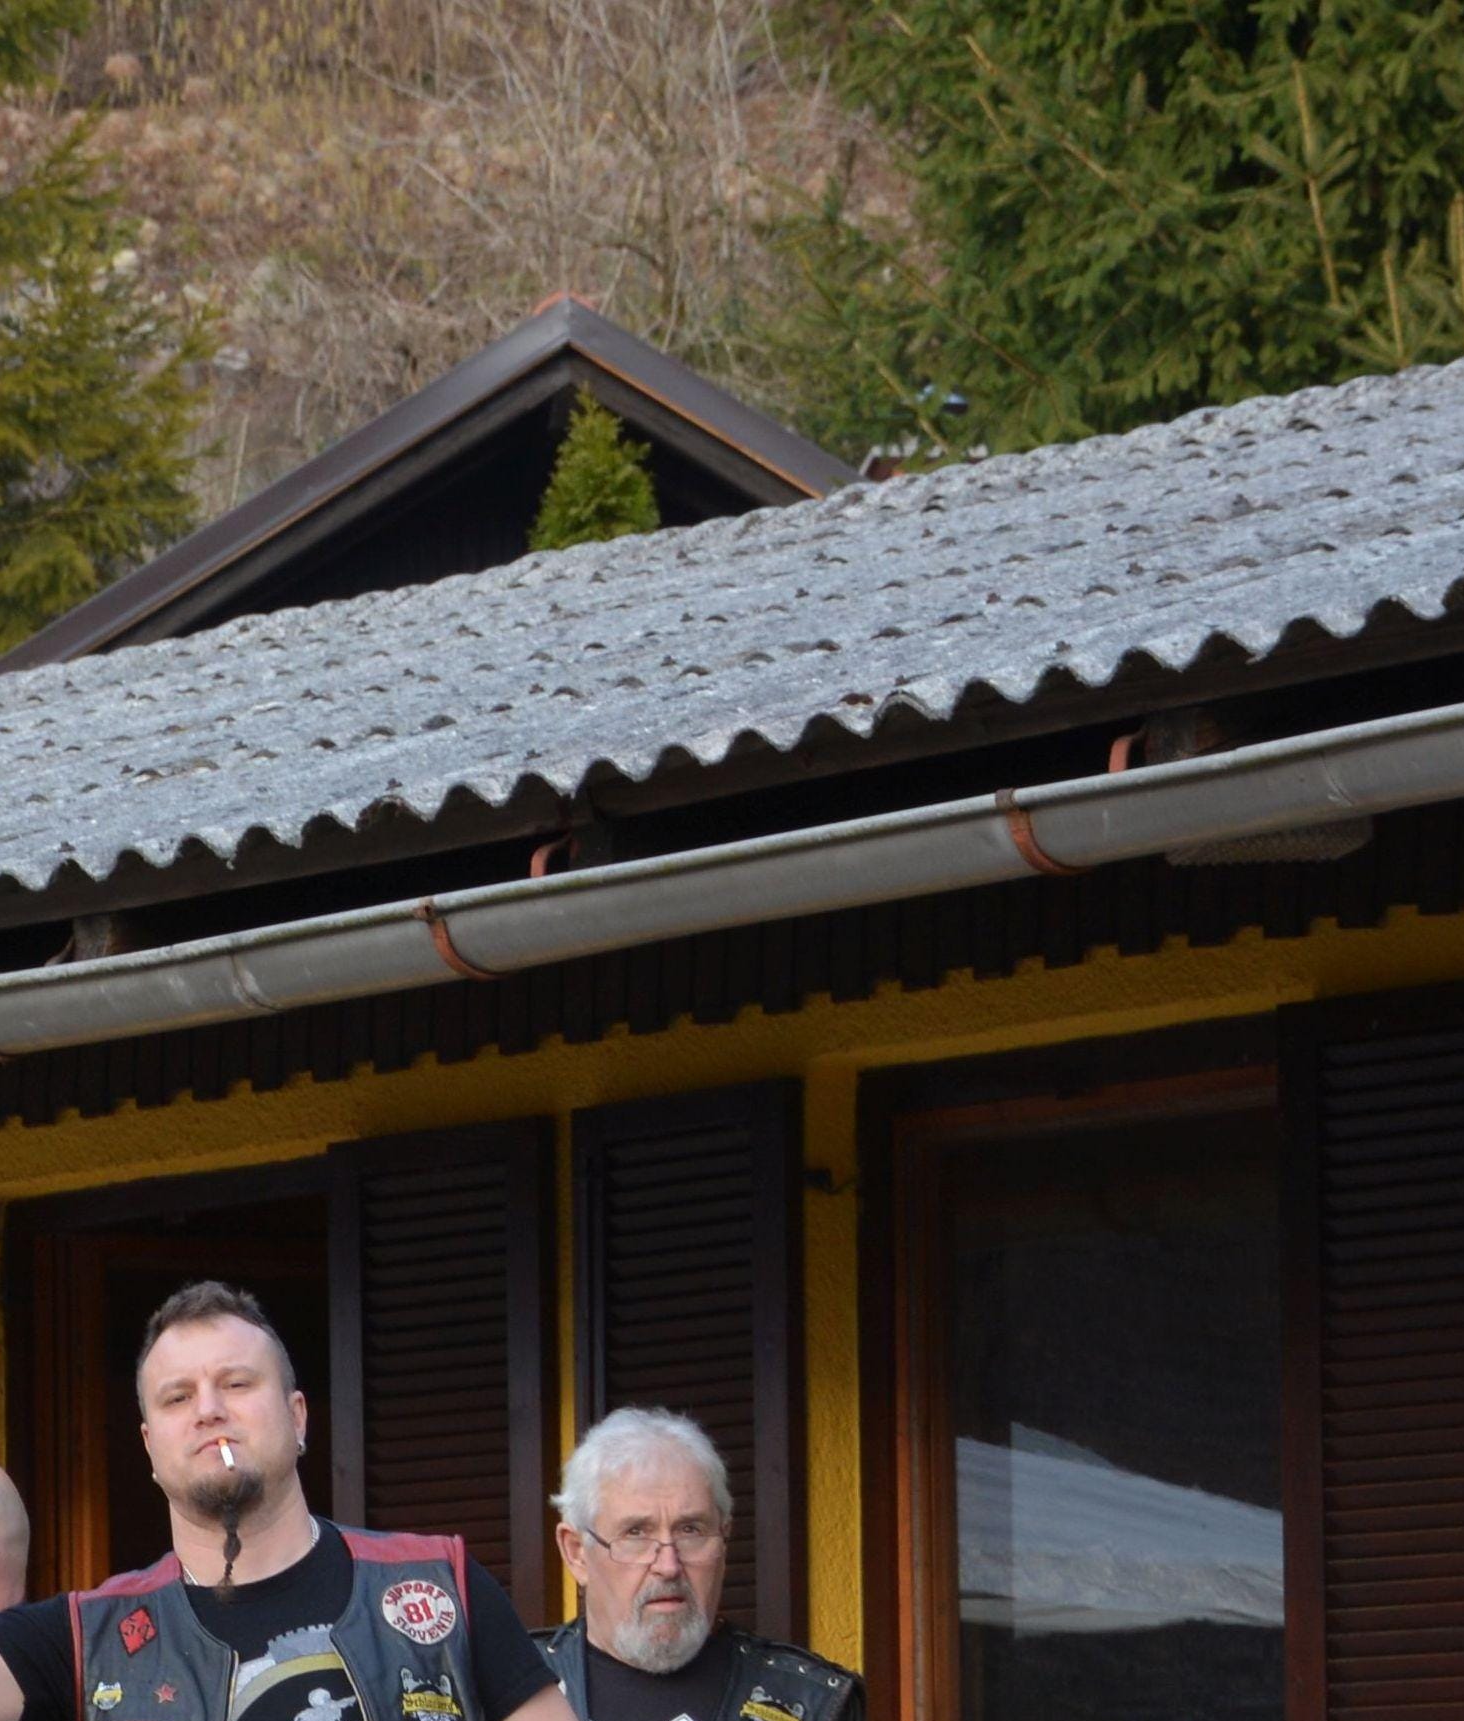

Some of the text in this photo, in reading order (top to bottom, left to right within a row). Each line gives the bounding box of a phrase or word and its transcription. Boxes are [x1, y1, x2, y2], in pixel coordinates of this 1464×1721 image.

[385, 1582, 446, 1606] SUPPORT
[403, 1597, 434, 1624] 81
[392, 1610, 454, 1640] SLOVENIA
